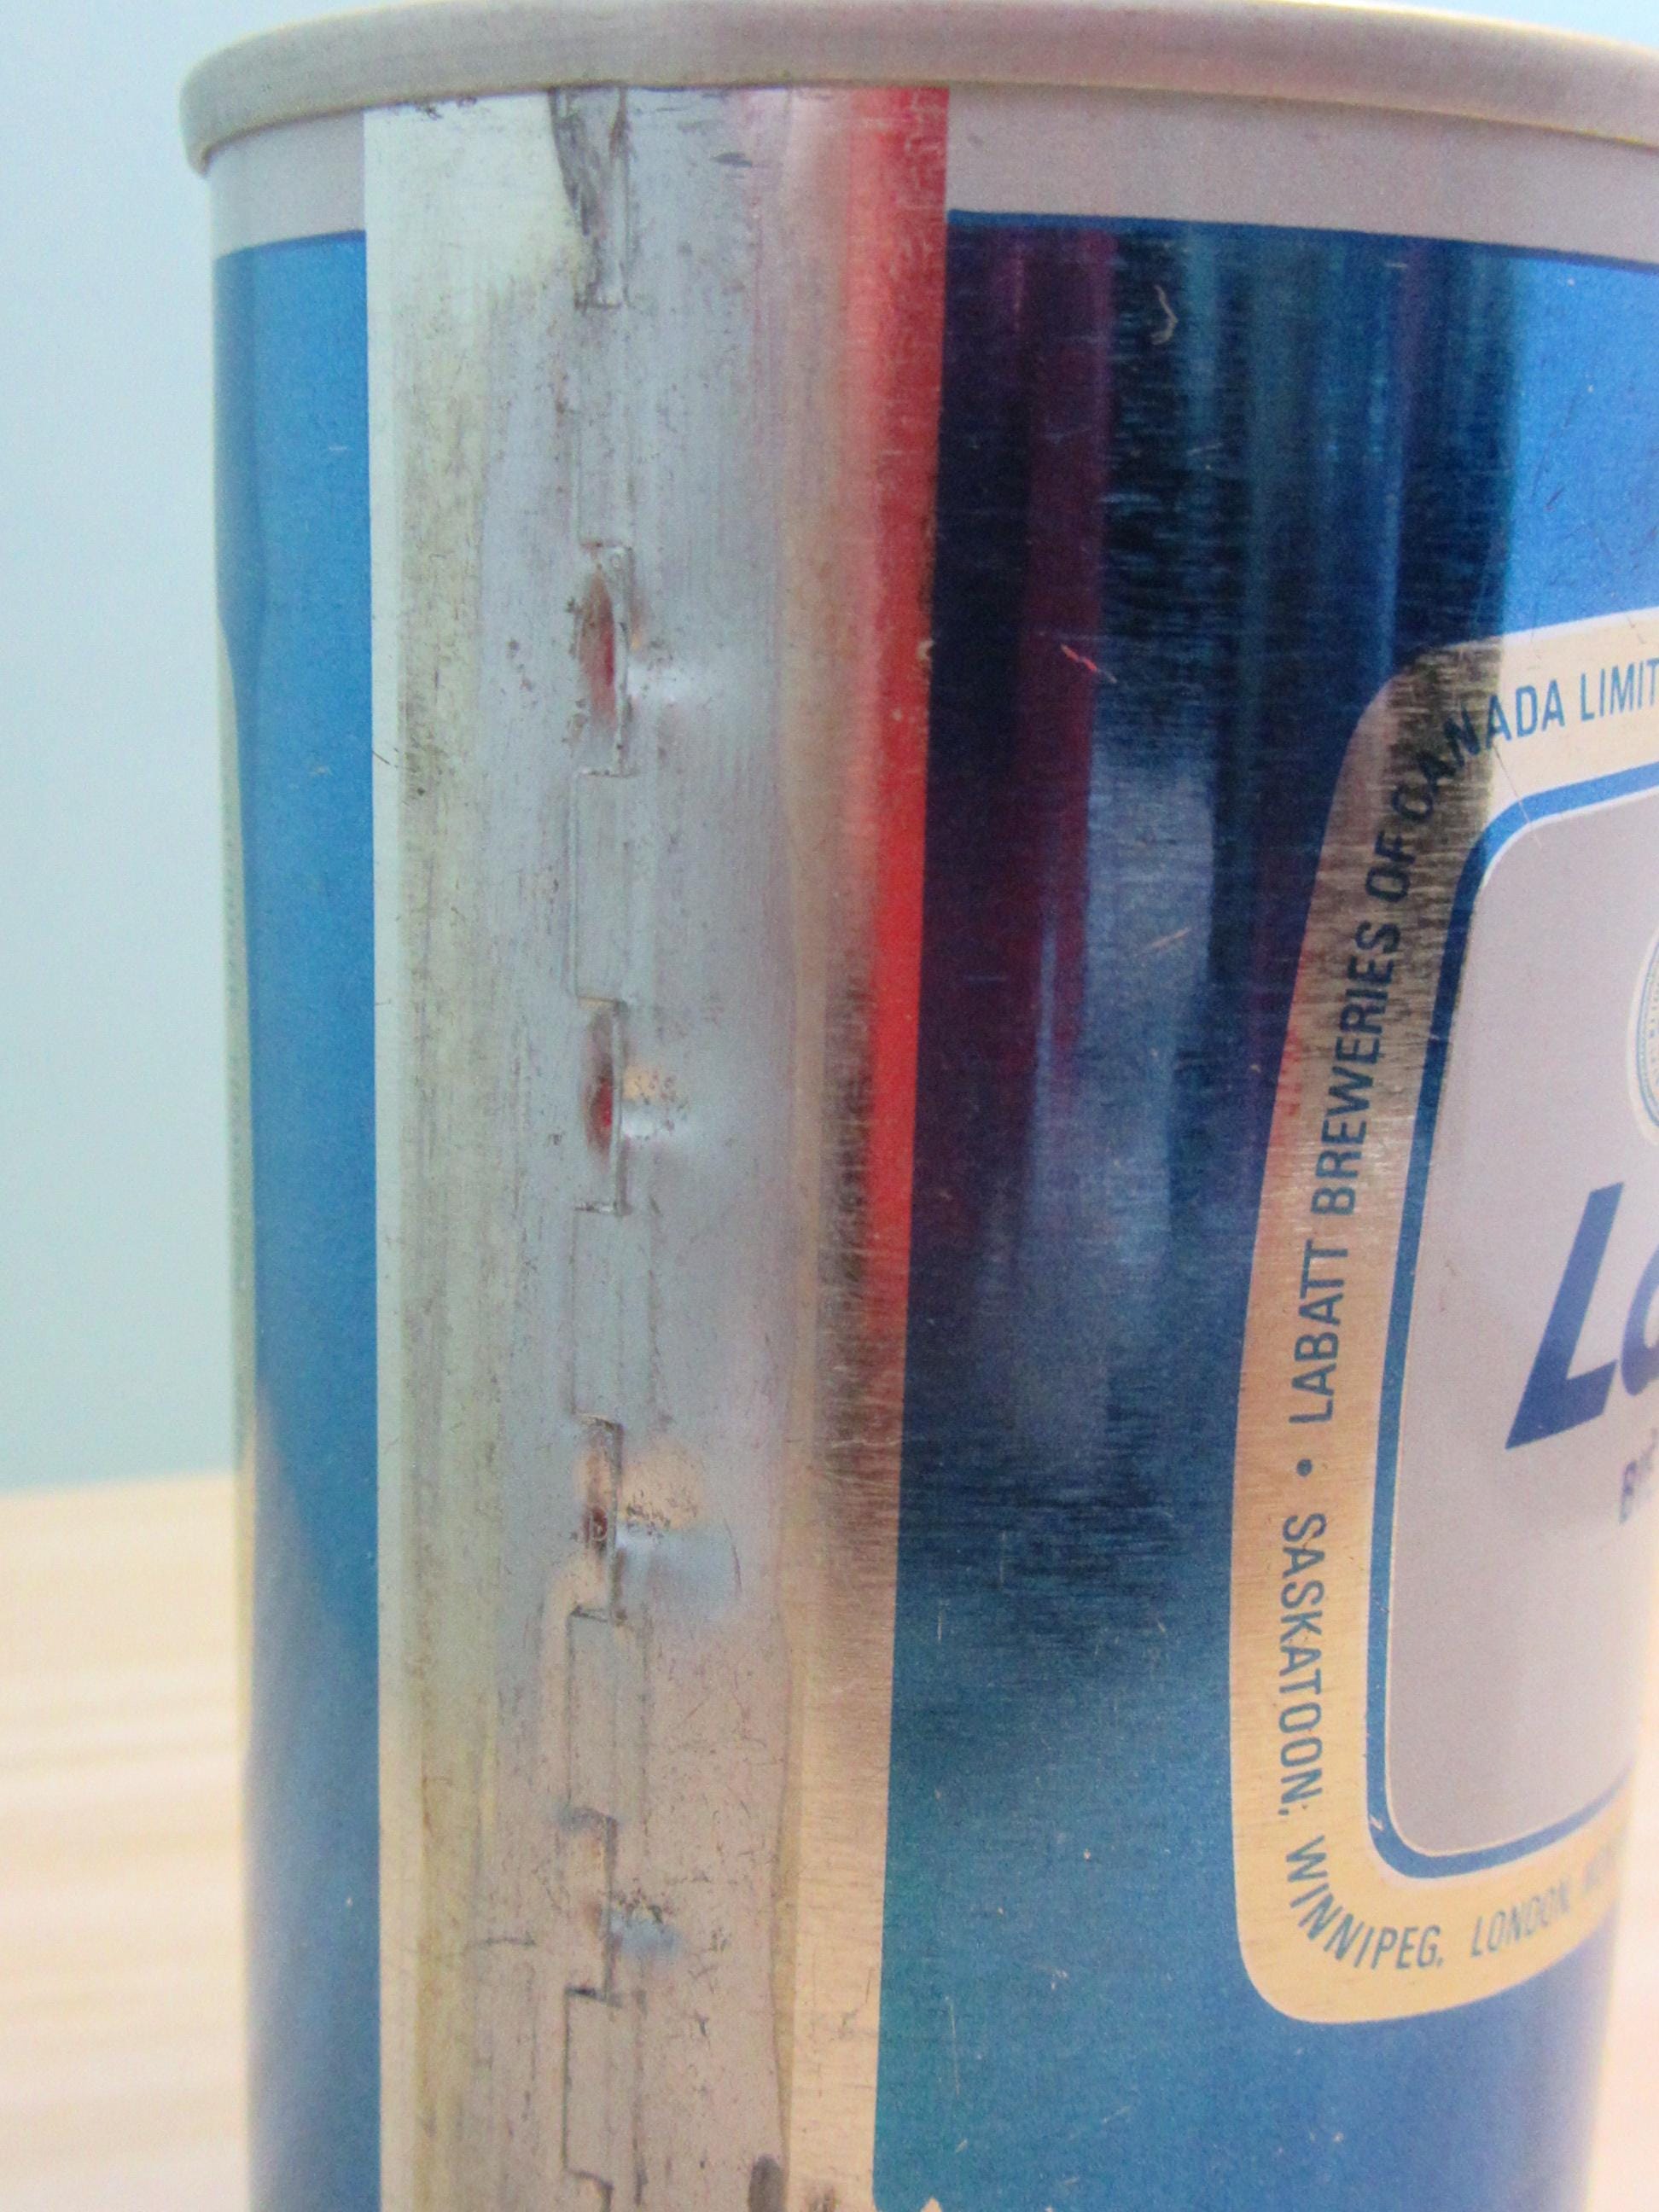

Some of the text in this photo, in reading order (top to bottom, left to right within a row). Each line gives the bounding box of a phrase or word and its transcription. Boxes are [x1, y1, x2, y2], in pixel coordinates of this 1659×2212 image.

[1390, 679, 1565, 823] CANADA
[1365, 830, 1416, 903] OF
[1311, 921, 1402, 1215] BREWERIES
[1289, 1240, 1348, 1423] LABATT
